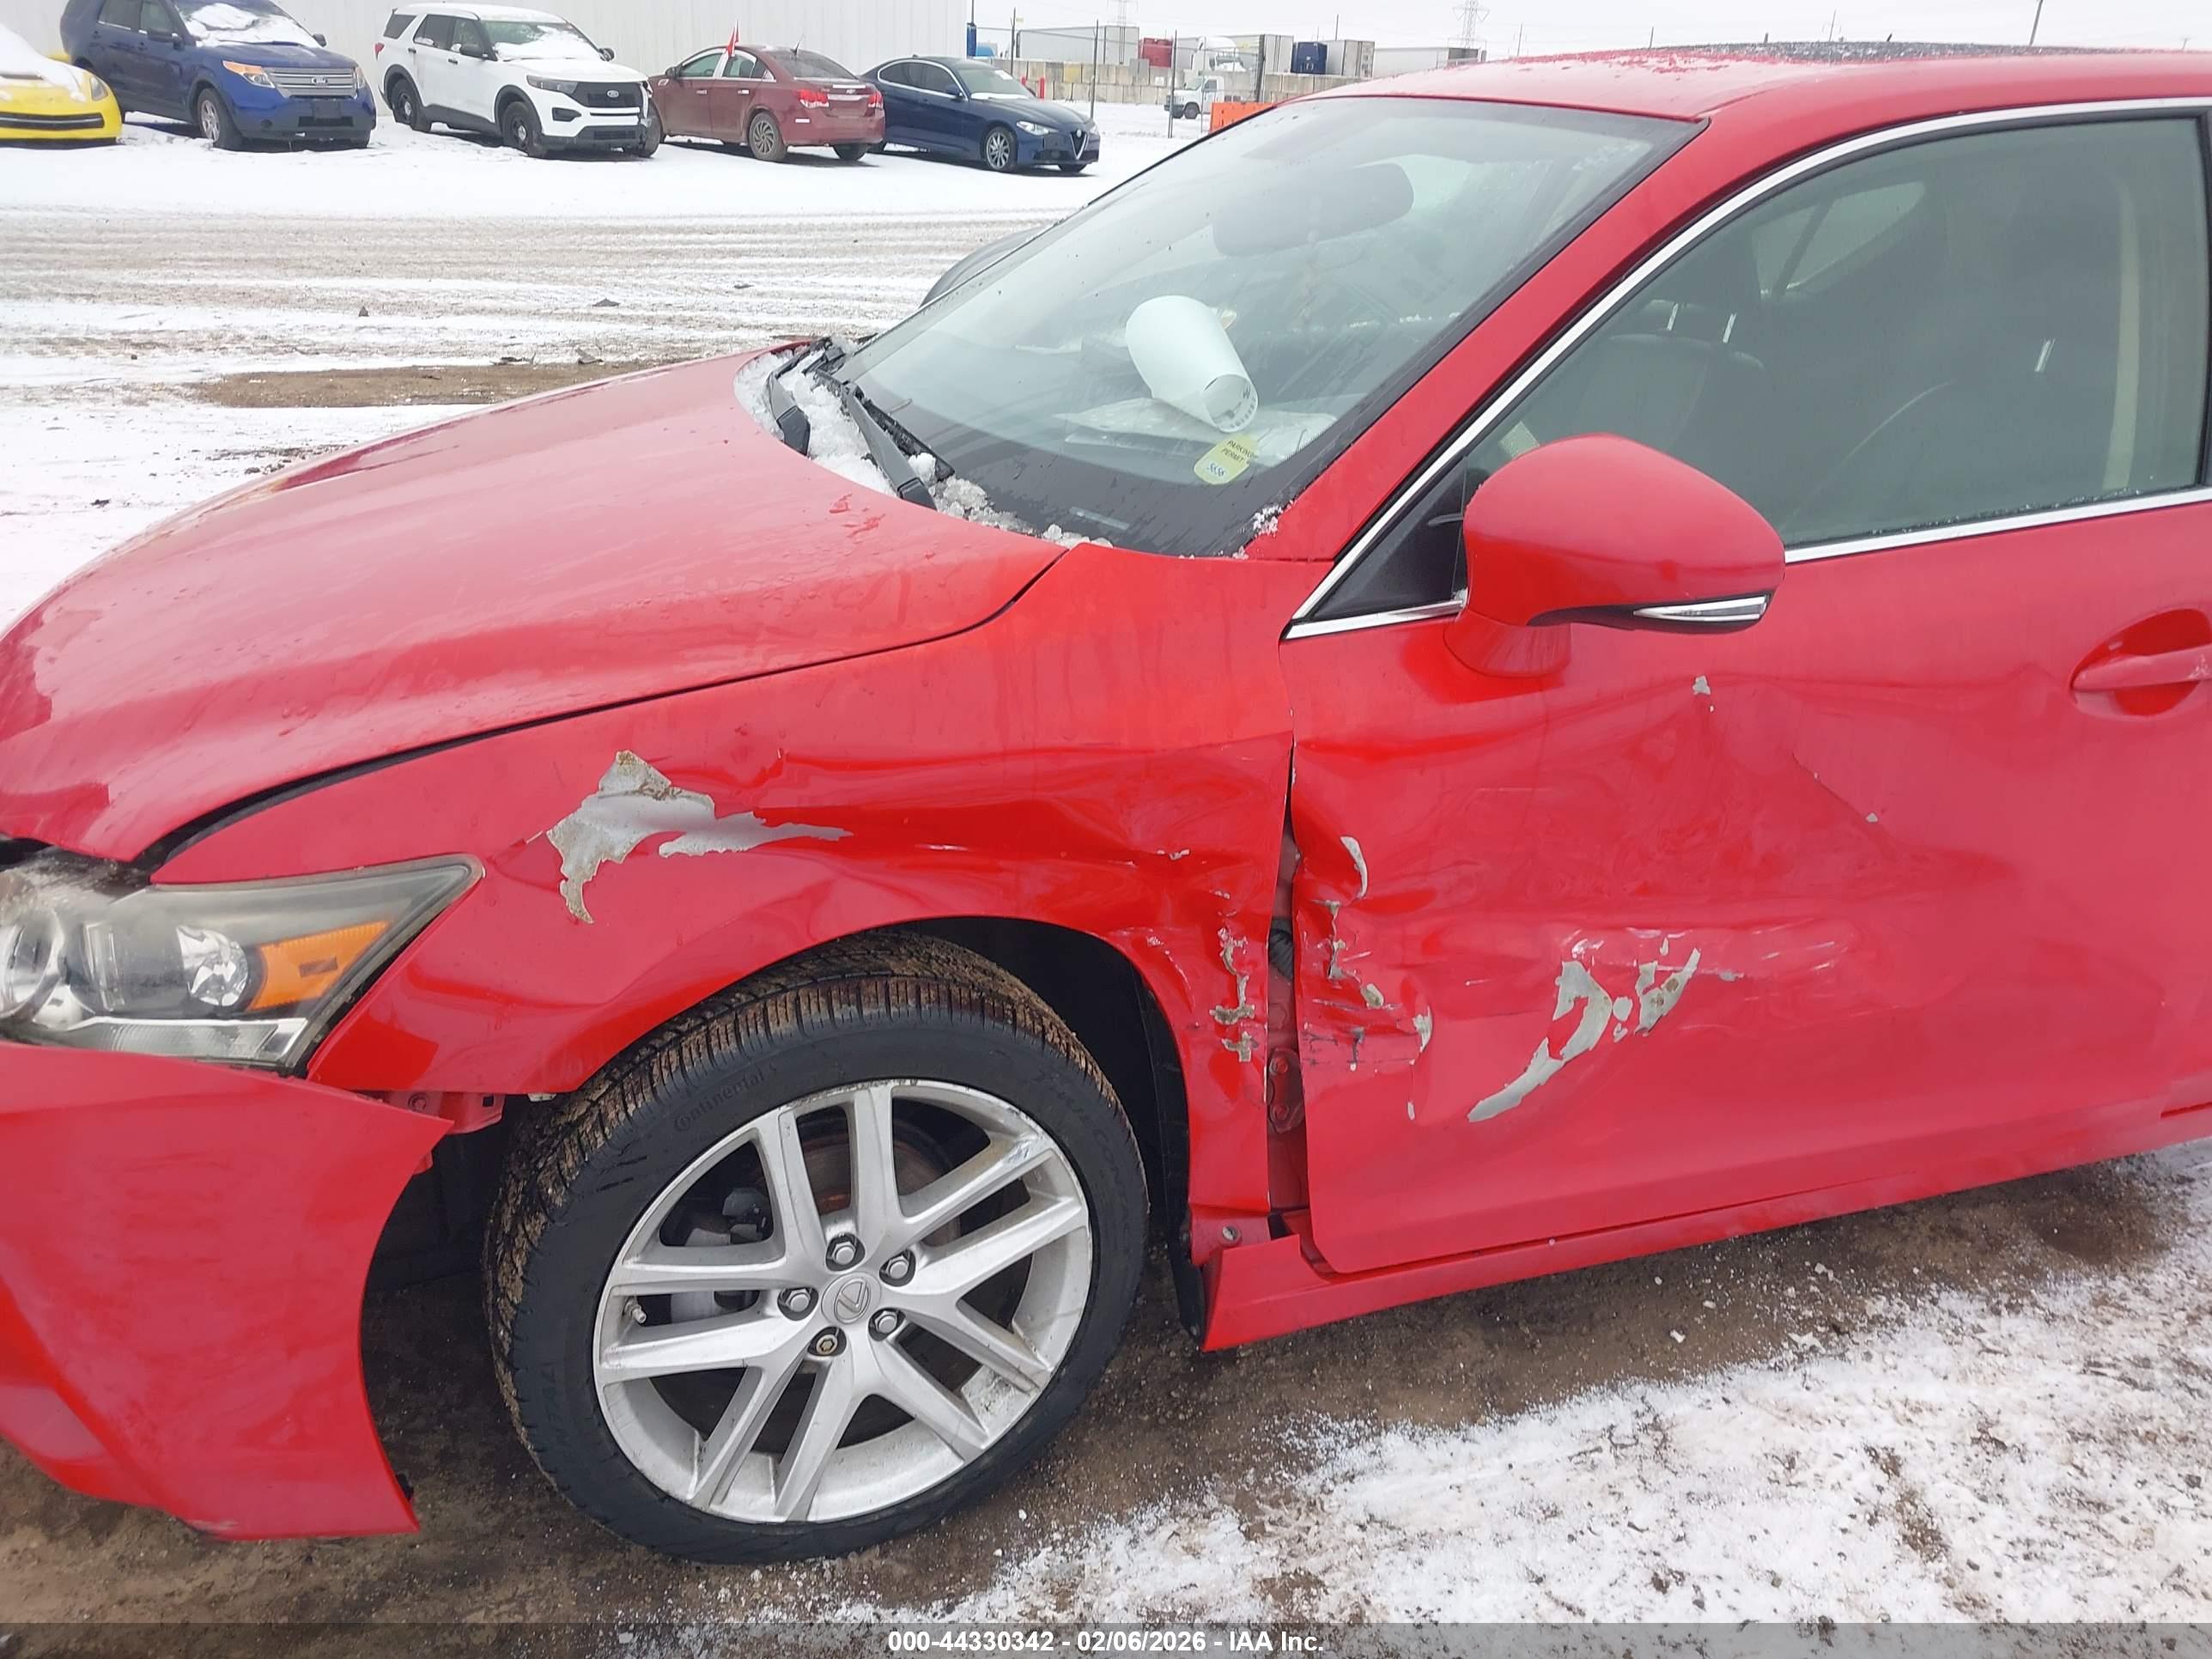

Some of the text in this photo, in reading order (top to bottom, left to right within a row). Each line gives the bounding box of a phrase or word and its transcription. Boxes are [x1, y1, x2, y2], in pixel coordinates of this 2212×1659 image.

[1222, 448, 1244, 462] PERMIT
[1227, 440, 1253, 459] PARKING
[672, 1066, 766, 1133] Continental
